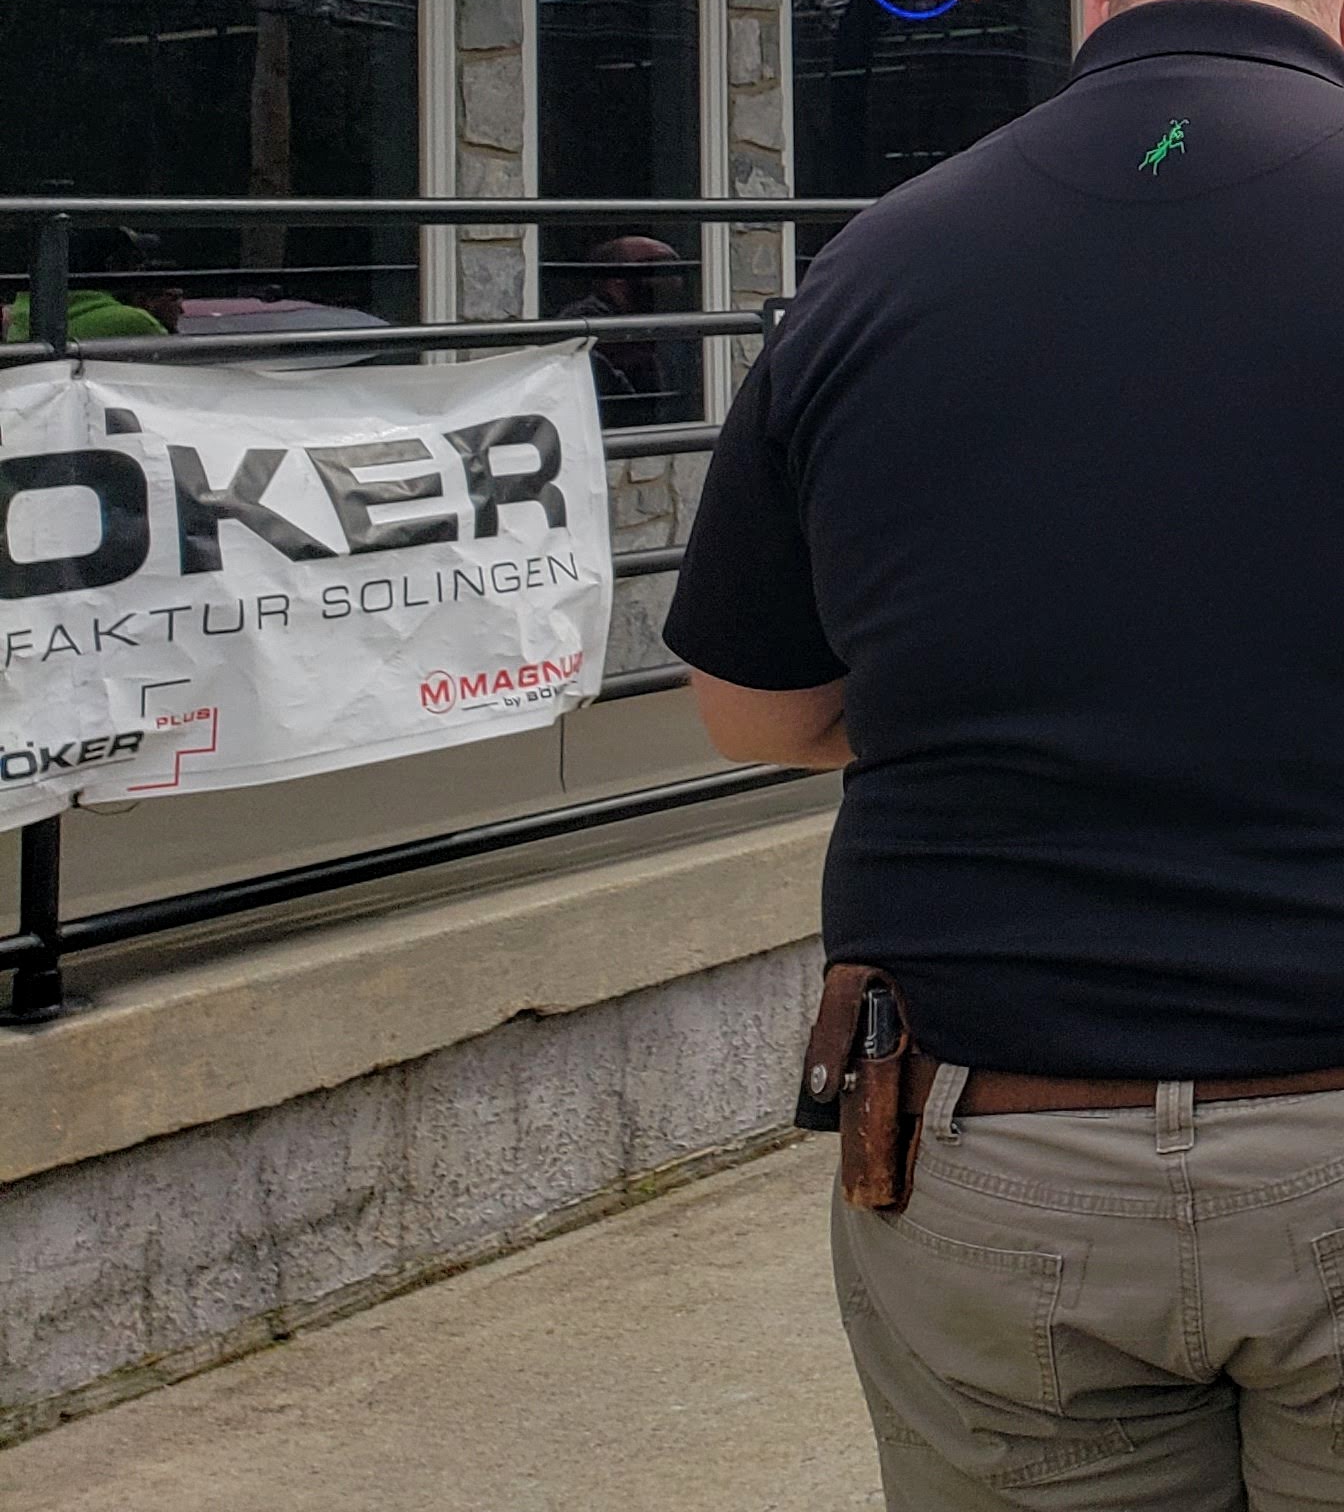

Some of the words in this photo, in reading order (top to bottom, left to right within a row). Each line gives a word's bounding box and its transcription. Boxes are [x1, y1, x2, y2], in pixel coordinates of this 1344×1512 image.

[322, 552, 580, 620] SOLINGEN
[503, 695, 521, 708] by
[156, 708, 211, 729] PLUS
